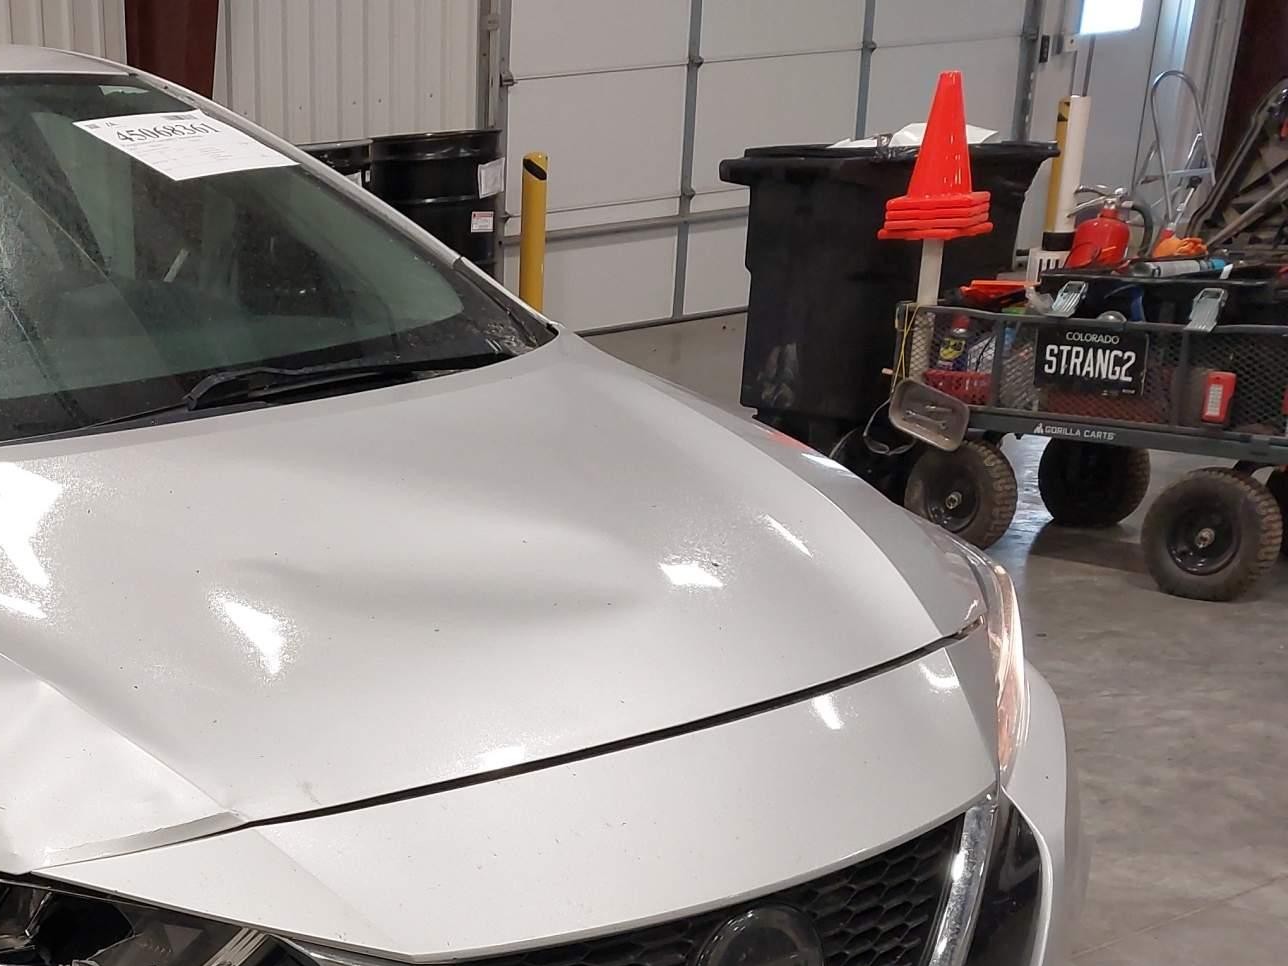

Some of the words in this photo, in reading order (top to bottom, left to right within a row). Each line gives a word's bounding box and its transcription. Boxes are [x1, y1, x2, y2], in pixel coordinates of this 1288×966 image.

[116, 123, 221, 142] 45068361
[1066, 332, 1120, 344] COLORADO
[1044, 344, 1136, 382] STRANG2
[1045, 425, 1081, 437] GORILLA
[1083, 429, 1116, 441] CARTS
